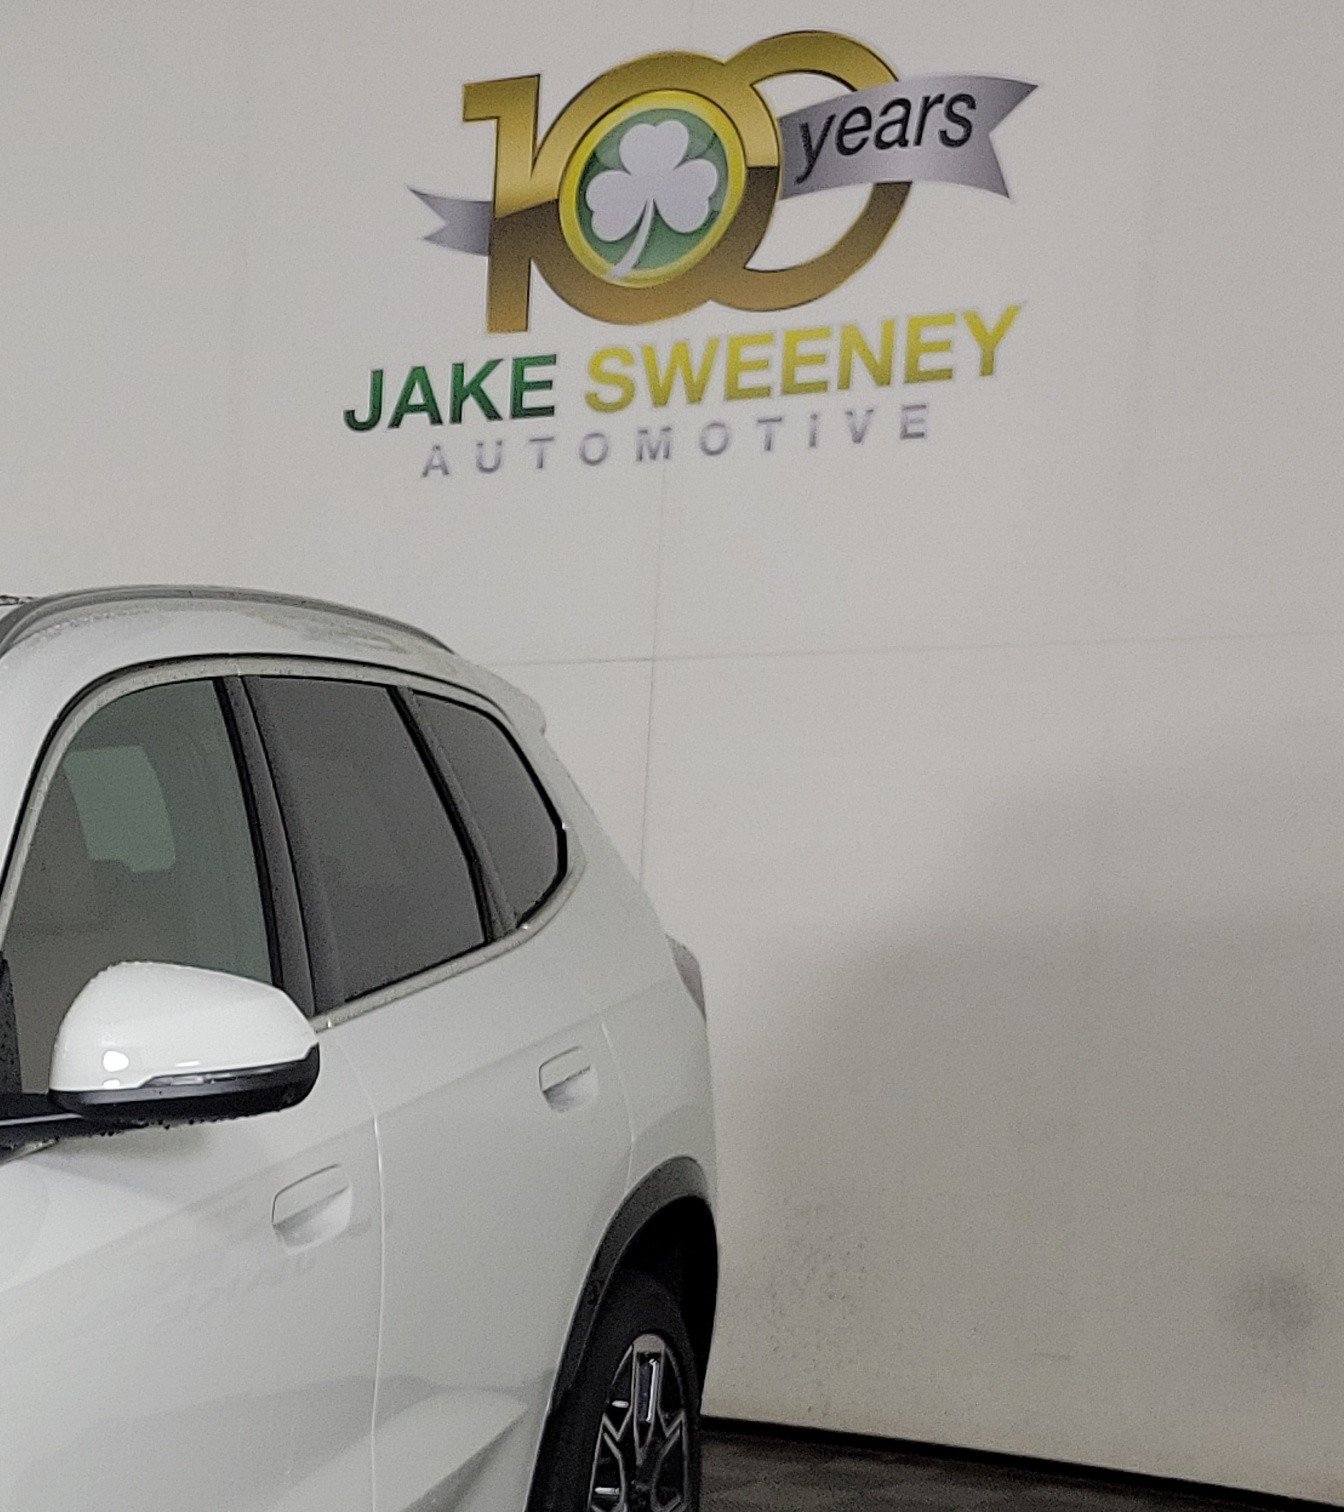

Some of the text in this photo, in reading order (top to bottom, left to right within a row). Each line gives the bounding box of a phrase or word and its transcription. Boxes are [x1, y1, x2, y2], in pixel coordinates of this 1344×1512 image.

[462, 30, 976, 333] 100 years
[343, 304, 1021, 432] JAKE SWEENEY
[421, 404, 930, 478] AUTOMOTIVE
